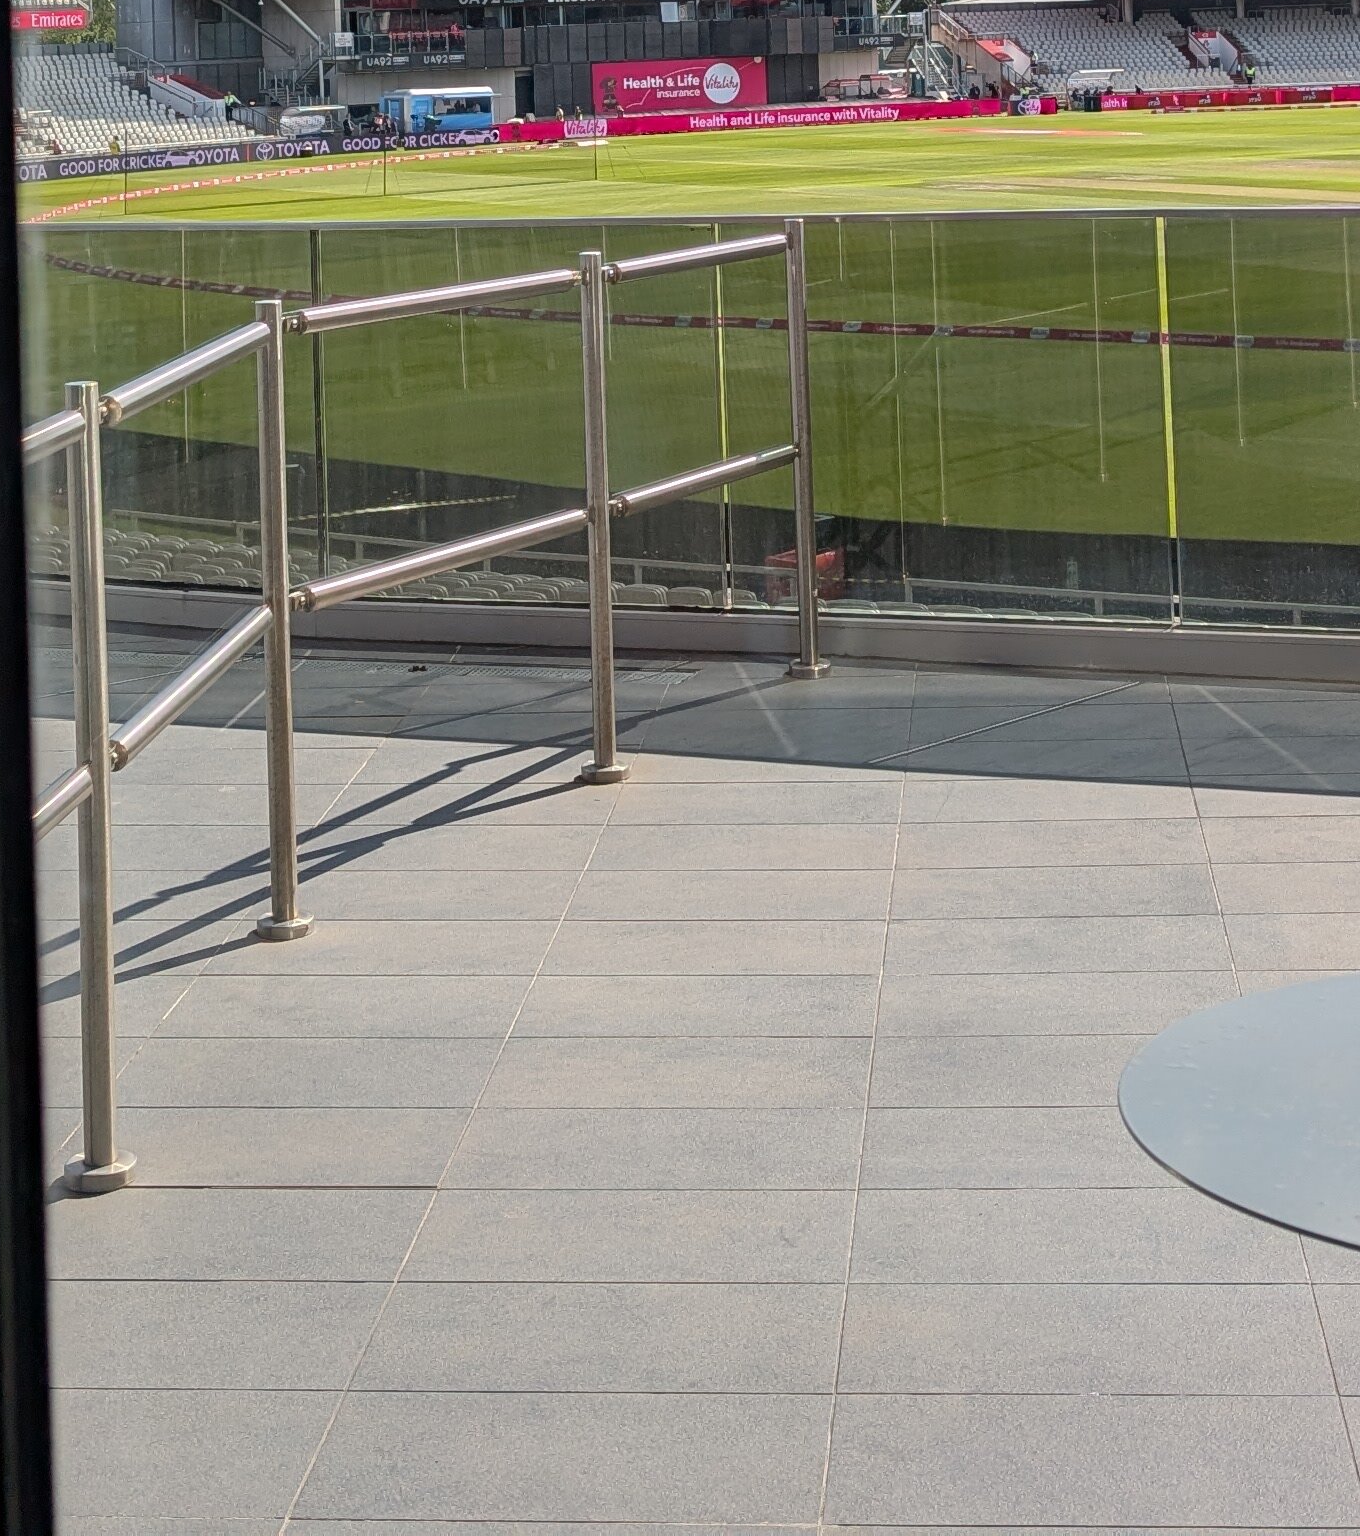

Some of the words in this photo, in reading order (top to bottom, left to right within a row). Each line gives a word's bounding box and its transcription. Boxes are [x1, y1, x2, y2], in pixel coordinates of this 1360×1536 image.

[31, 13, 83, 27] Emirates
[424, 55, 448, 64] UA92
[623, 75, 664, 89] Health
[667, 75, 675, 87] &
[678, 74, 700, 87] Life
[704, 74, 740, 95] Vitality
[656, 87, 701, 99] insurance
[690, 115, 728, 129] Health
[730, 113, 752, 126] and
[755, 112, 775, 125] Life
[777, 111, 830, 124] insurance
[832, 109, 858, 121] with
[860, 106, 899, 121] Vitality
[565, 120, 607, 137] Vitality
[342, 137, 381, 151] GOOD
[59, 161, 96, 177] GOOD
[98, 159, 120, 173] FOR
[122, 155, 165, 171] CRICKE
